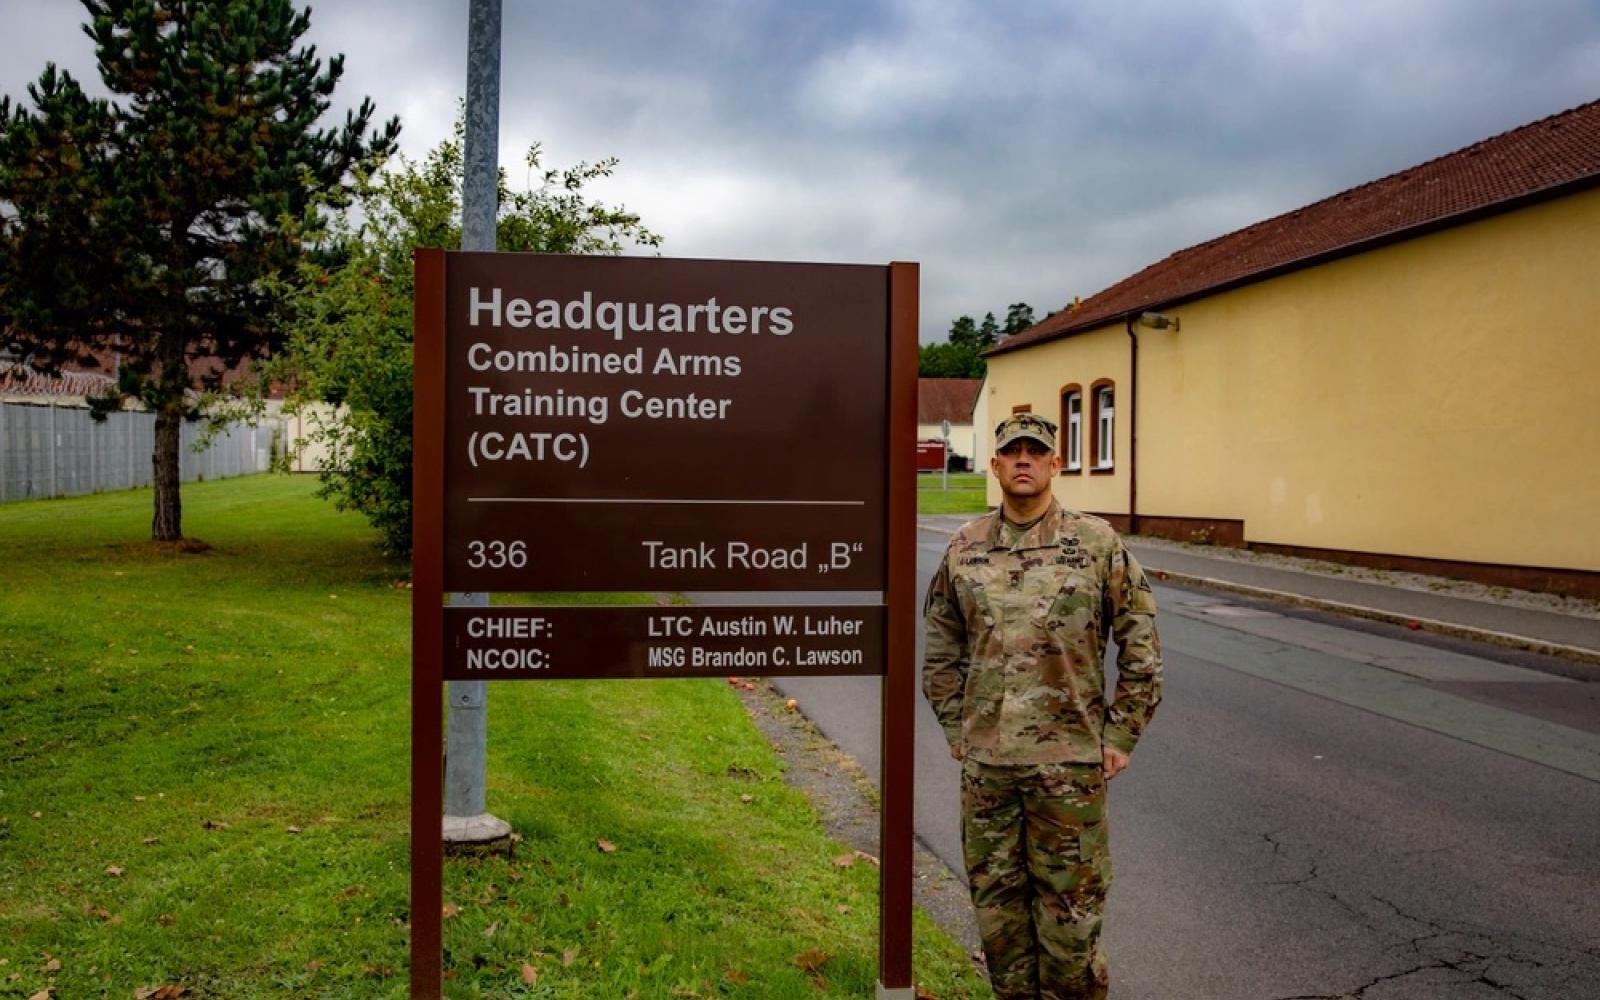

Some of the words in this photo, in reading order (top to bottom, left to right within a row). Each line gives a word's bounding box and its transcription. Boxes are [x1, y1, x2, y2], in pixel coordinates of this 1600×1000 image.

[468, 287, 794, 341] Headquarters
[468, 342, 643, 375] Combined
[652, 347, 742, 377] Arms
[468, 387, 608, 424] Training
[620, 390, 732, 420] Center
[467, 432, 589, 469] (CATC)
[467, 540, 527, 568] 336
[642, 541, 716, 569] Tank
[727, 542, 808, 569] Road
[467, 617, 553, 638] CHIEF:
[648, 616, 692, 636] LTC
[700, 616, 767, 636] Austin
[773, 616, 797, 635] W.
[804, 615, 863, 635] Luher
[466, 648, 550, 669] NCOIC:
[648, 646, 686, 667] MSG
[692, 646, 767, 667] Brandon
[772, 646, 790, 666] C.
[796, 646, 863, 666] Lawson
